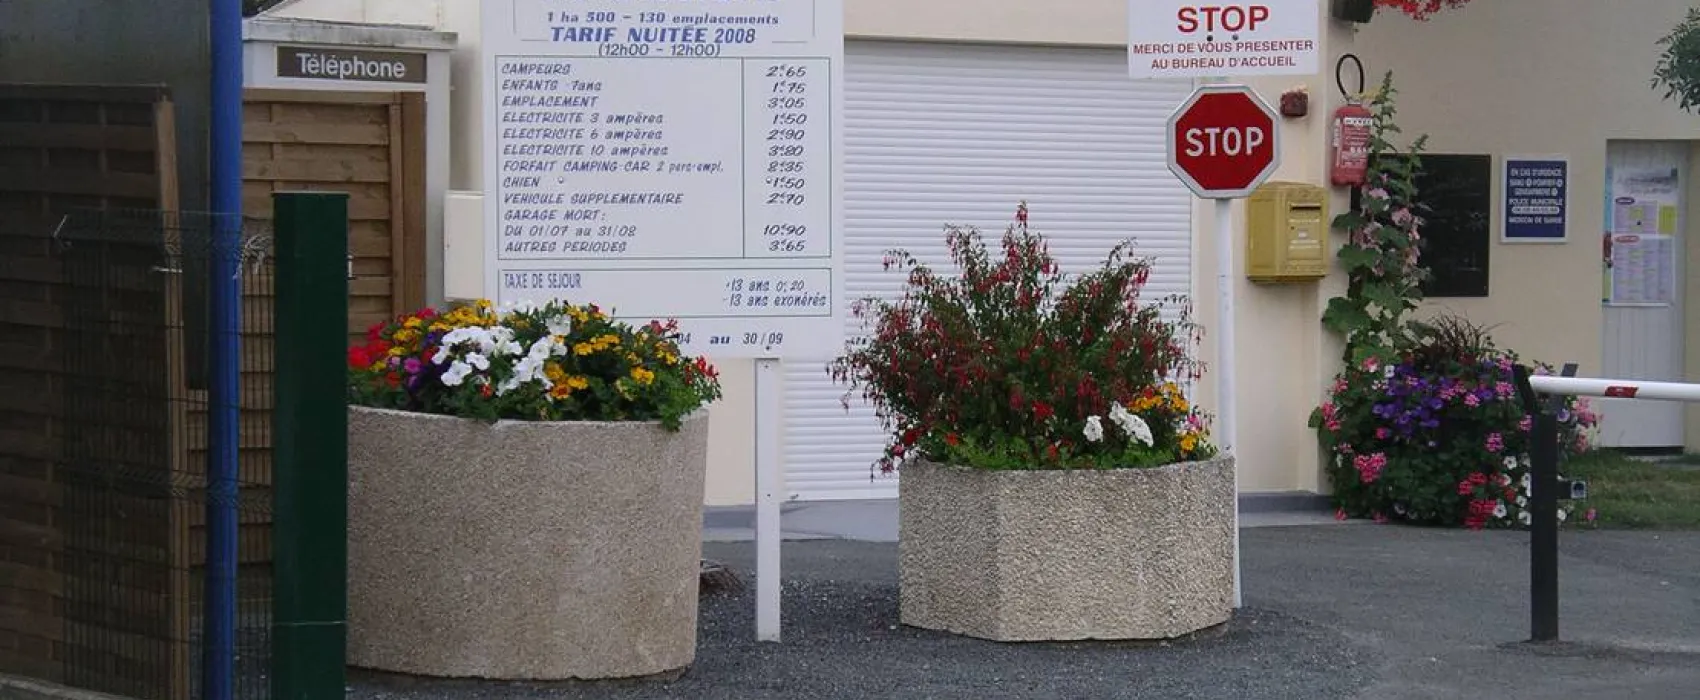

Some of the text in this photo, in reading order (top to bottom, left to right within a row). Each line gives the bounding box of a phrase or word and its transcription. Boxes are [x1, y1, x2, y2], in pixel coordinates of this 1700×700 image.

[547, 12, 553, 22] 1
[561, 12, 578, 22] ha
[586, 12, 615, 22] 500
[639, 12, 666, 23] 130
[672, 12, 779, 26] emplacements
[1177, 5, 1269, 33] STOP
[550, 25, 756, 44] TARIF NUITÉE 2008
[598, 43, 649, 57] (12h00
[671, 43, 721, 57] 12h00)
[1133, 40, 1313, 55] MERCI DE VOUS PRESENTER
[295, 53, 406, 80] Téléphone
[501, 63, 571, 75] CAMPEURS
[1151, 56, 1297, 70] AU BUREAU D'ACCUEIL
[501, 79, 558, 91] ENFANTS
[502, 96, 599, 107] EMPLACEMENT
[502, 112, 583, 123] ELECTRICITE
[590, 112, 599, 123] 3
[503, 128, 583, 139] ELECTRICITE
[590, 128, 599, 139] 6
[1186, 126, 1264, 157] STOP
[503, 145, 585, 156] ELECTRICITE
[590, 145, 604, 156] 10
[503, 161, 557, 172] FORFAIT
[656, 161, 665, 172] 2
[503, 177, 541, 188] CHIEN
[504, 193, 565, 204] VEHICULE
[570, 193, 684, 205] SUPPLEMENTAIRE
[504, 209, 557, 221] GARAGE
[505, 225, 523, 237] DU
[576, 227, 591, 236] au
[505, 241, 557, 252] AUTRES
[563, 241, 627, 253] PERIODES
[504, 273, 582, 289] TAXE DE SEJOUR
[749, 280, 770, 292] ans
[746, 295, 769, 307] ans
[774, 291, 827, 307] exonérés
[710, 335, 730, 345] au
